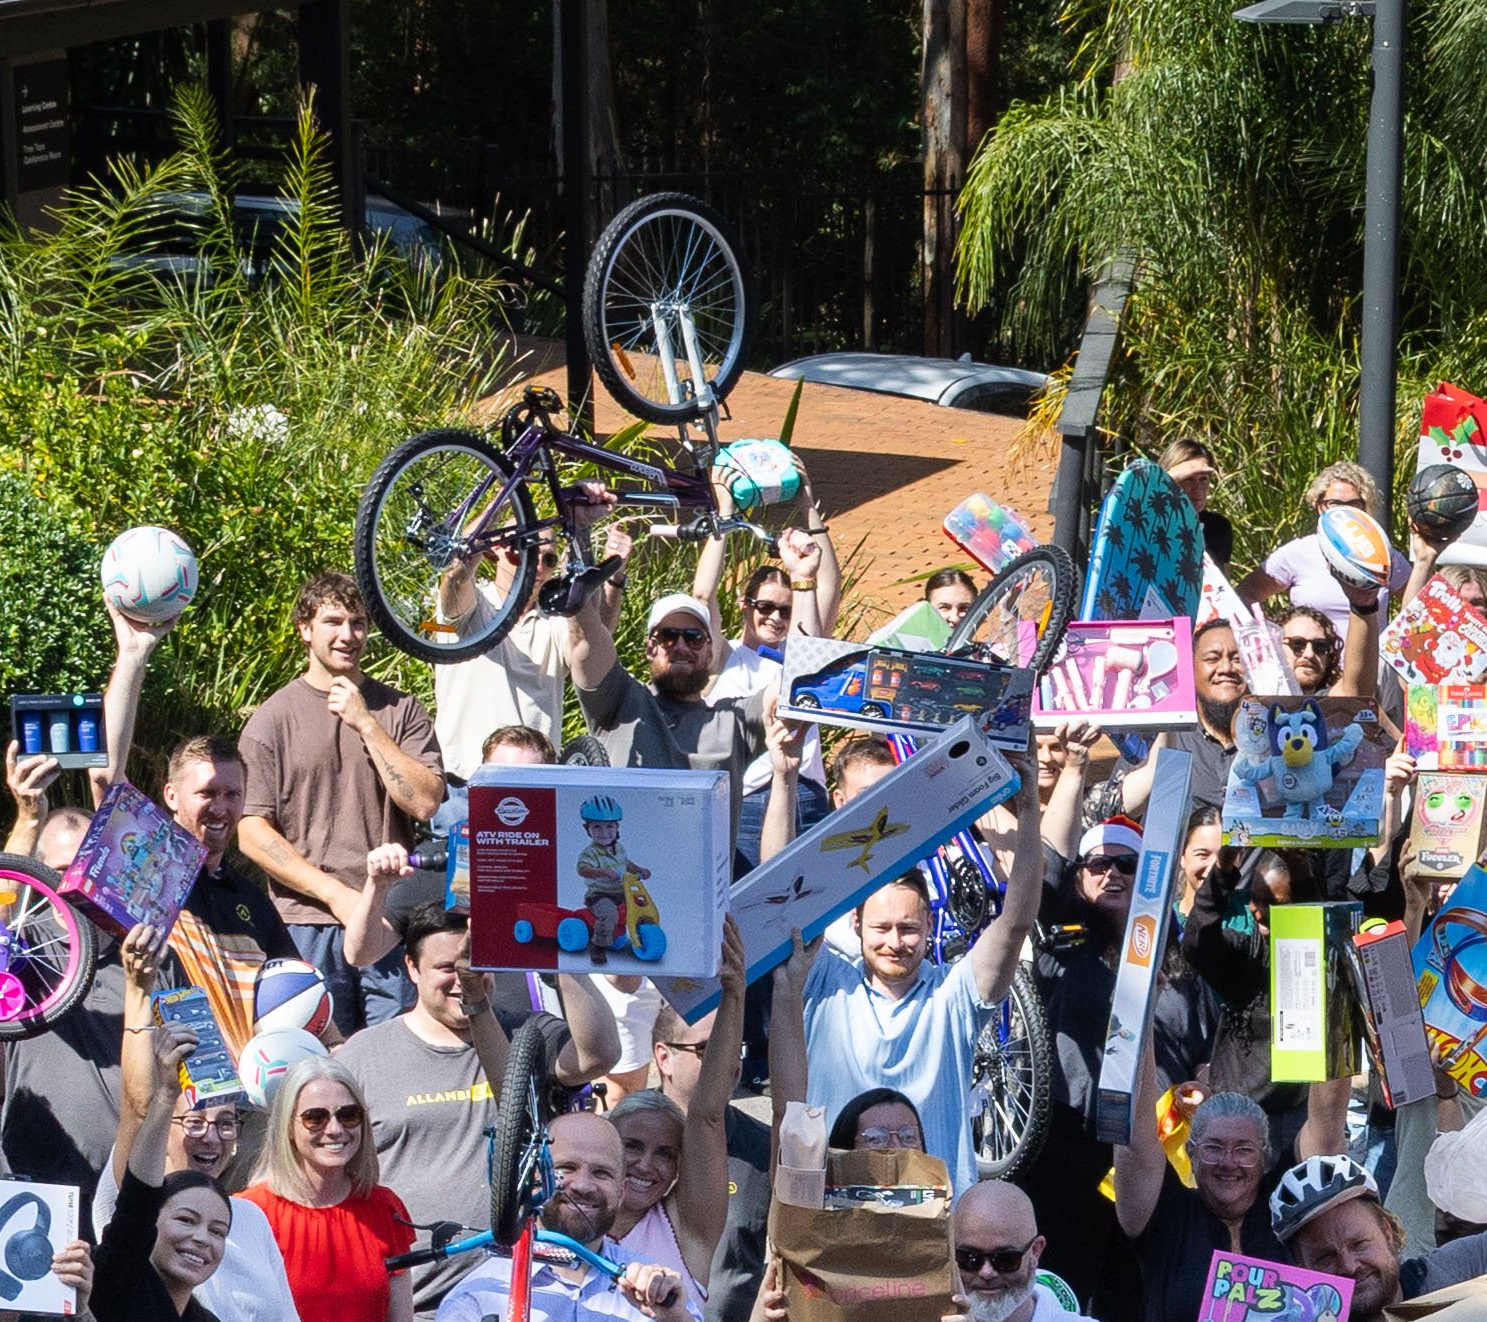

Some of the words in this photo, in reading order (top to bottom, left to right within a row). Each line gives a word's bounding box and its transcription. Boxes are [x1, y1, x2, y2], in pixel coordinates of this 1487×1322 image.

[1429, 579, 1462, 615] Trolli
[476, 831, 495, 840] ATV
[498, 831, 523, 840] RIDE
[526, 832, 541, 841] ON
[476, 838, 502, 847] WITH
[505, 838, 550, 848] TRAILER
[90, 846, 111, 876] Friends
[1421, 851, 1462, 864] FUGGLER
[1145, 855, 1157, 895] FORTNITE
[1136, 922, 1149, 956] NERF
[406, 1090, 471, 1106] ALLAMBI
[1217, 1260, 1277, 1289] POUR
[831, 1281, 926, 1304] priceline
[1214, 1276, 1283, 1311] PALZ
